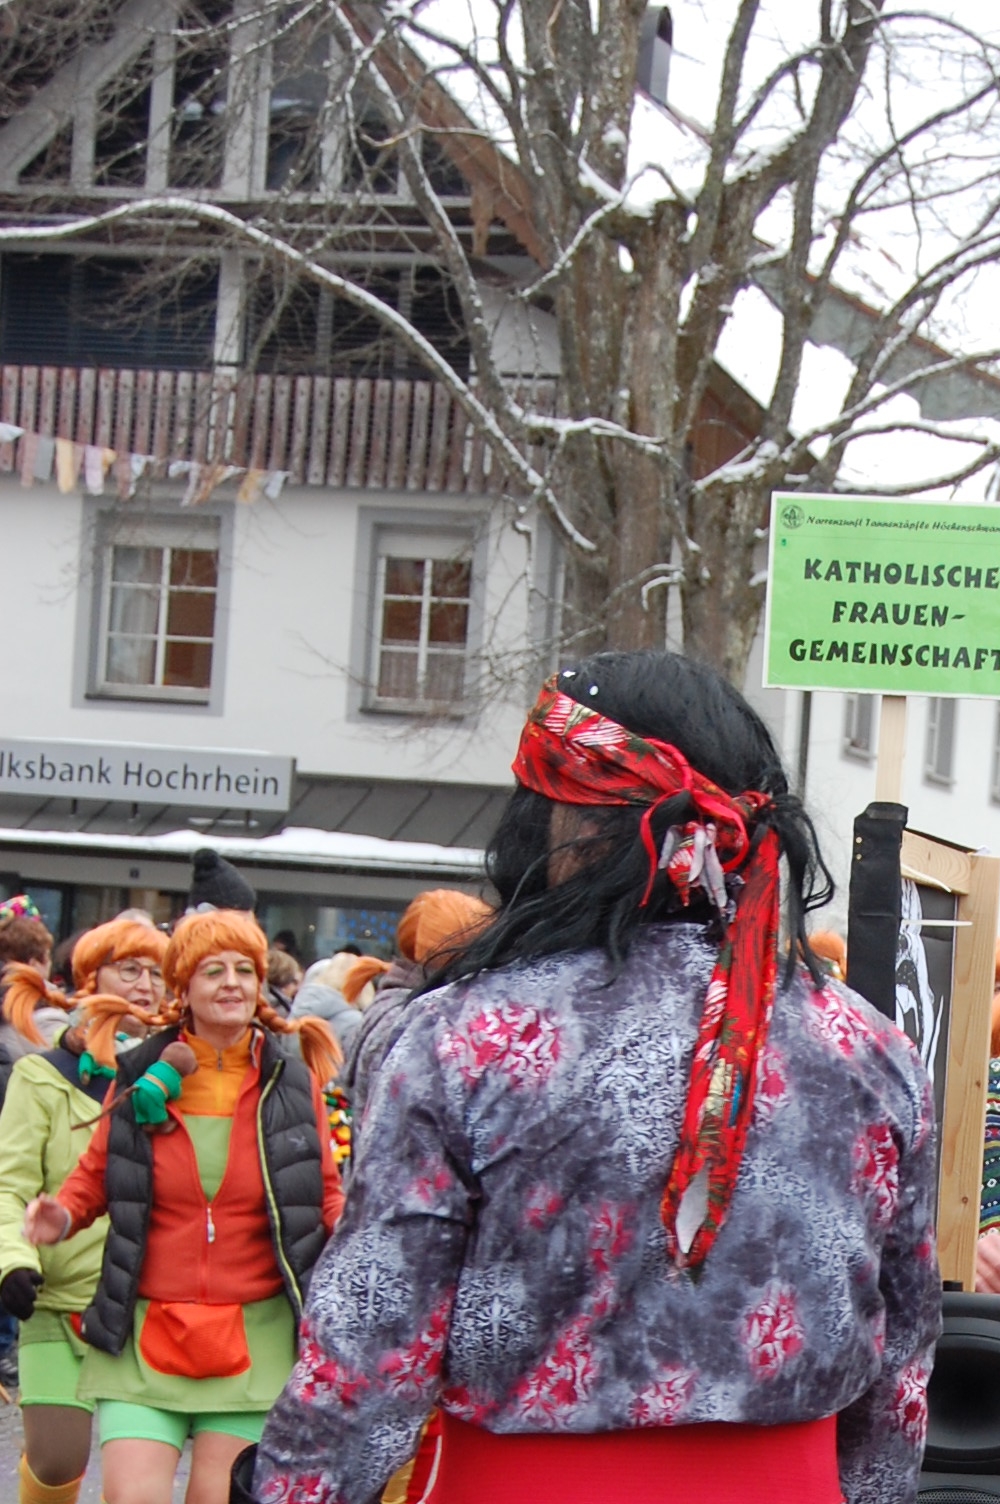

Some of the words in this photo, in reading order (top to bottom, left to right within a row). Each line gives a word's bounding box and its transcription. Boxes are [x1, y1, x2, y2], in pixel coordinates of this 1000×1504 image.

[803, 557, 1000, 590] KATHOLISCHE
[831, 600, 967, 628] FRAUEN-
[123, 760, 280, 796] Hochrhein
